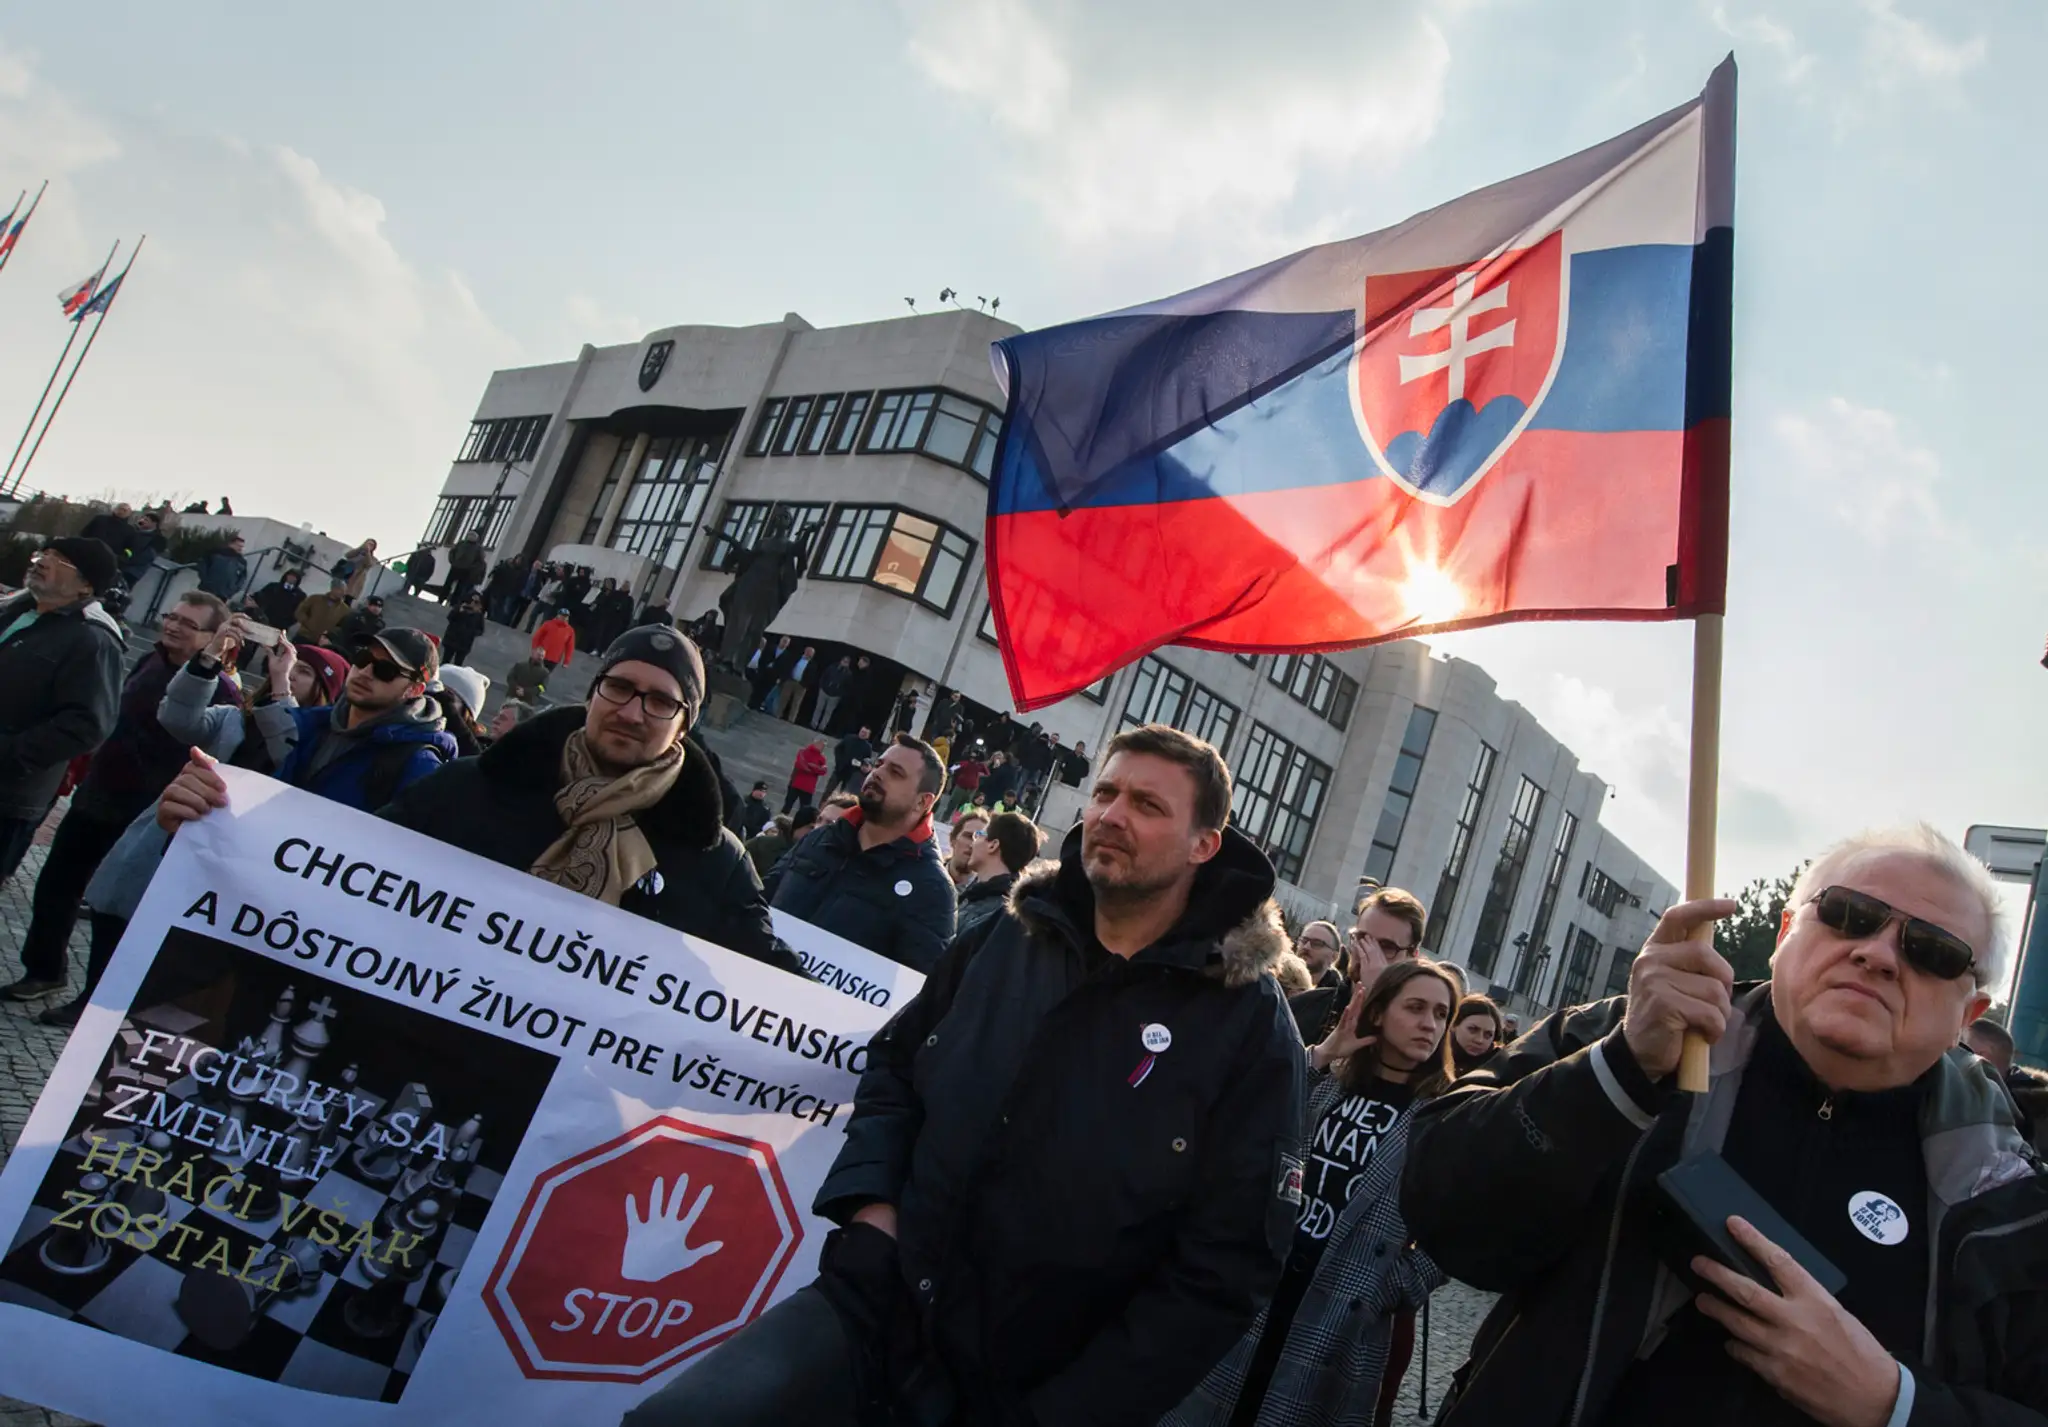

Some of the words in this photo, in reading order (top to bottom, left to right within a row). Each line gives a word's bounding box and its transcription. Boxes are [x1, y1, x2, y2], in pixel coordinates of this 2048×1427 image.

[182, 890, 218, 926] A
[230, 903, 461, 1004] DÔSTOJNÝ
[459, 976, 587, 1048] ŽIVOT
[587, 1027, 664, 1076] PRE
[671, 1053, 840, 1128] VŠETKÝCH
[273, 837, 475, 934] CHCEME
[477, 911, 649, 996] SLUŠNÉ
[648, 973, 868, 1075] SLOVENSKO
[103, 1083, 334, 1182] ZMENILI
[130, 1028, 376, 1132] FIGÚRKY
[379, 1112, 447, 1161] SA
[50, 1190, 294, 1293] ZOSTALI
[77, 1136, 262, 1220] HRÁČI
[278, 1192, 425, 1269] VŠAK
[1852, 1210, 1870, 1227] FOR
[1868, 1225, 1885, 1240] JAN
[550, 1287, 693, 1339] STOP
